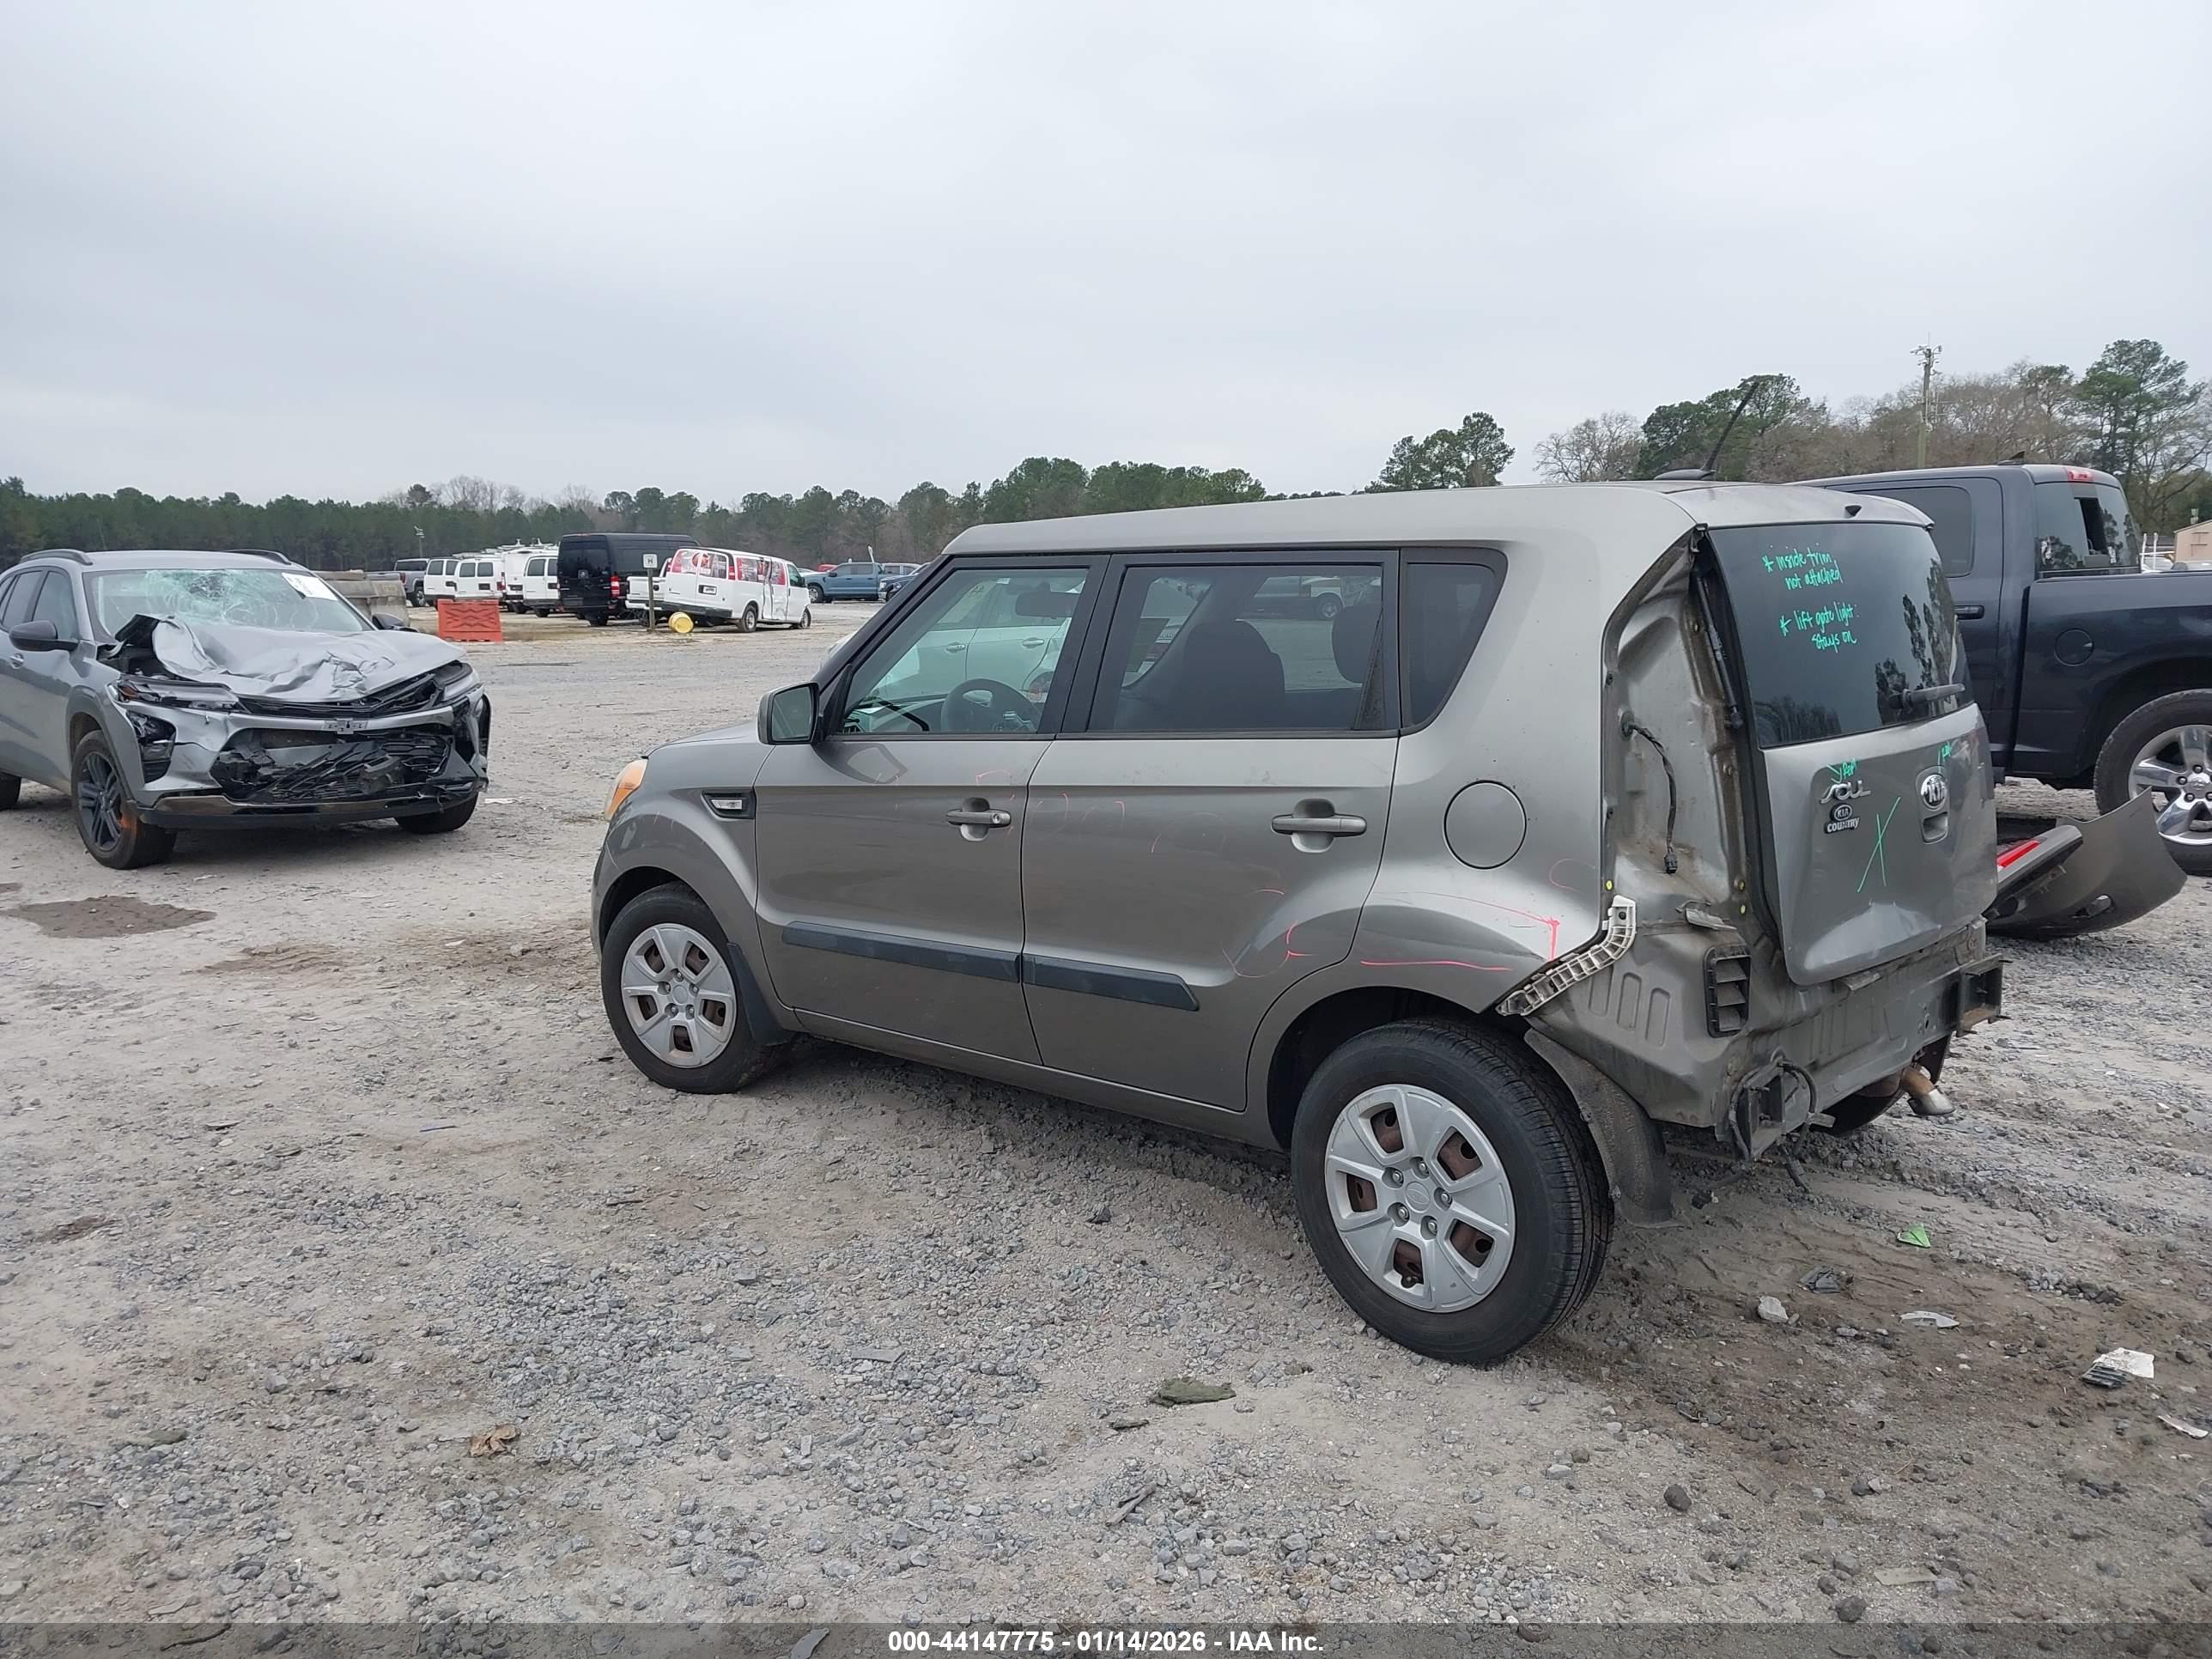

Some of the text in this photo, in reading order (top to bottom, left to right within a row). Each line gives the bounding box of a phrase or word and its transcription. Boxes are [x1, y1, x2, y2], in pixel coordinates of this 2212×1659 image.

[1775, 545, 1832, 570] inside trim
[1784, 560, 1844, 590] not attached
[1793, 610, 1814, 631] lift
[1837, 807, 1849, 818] KIA
